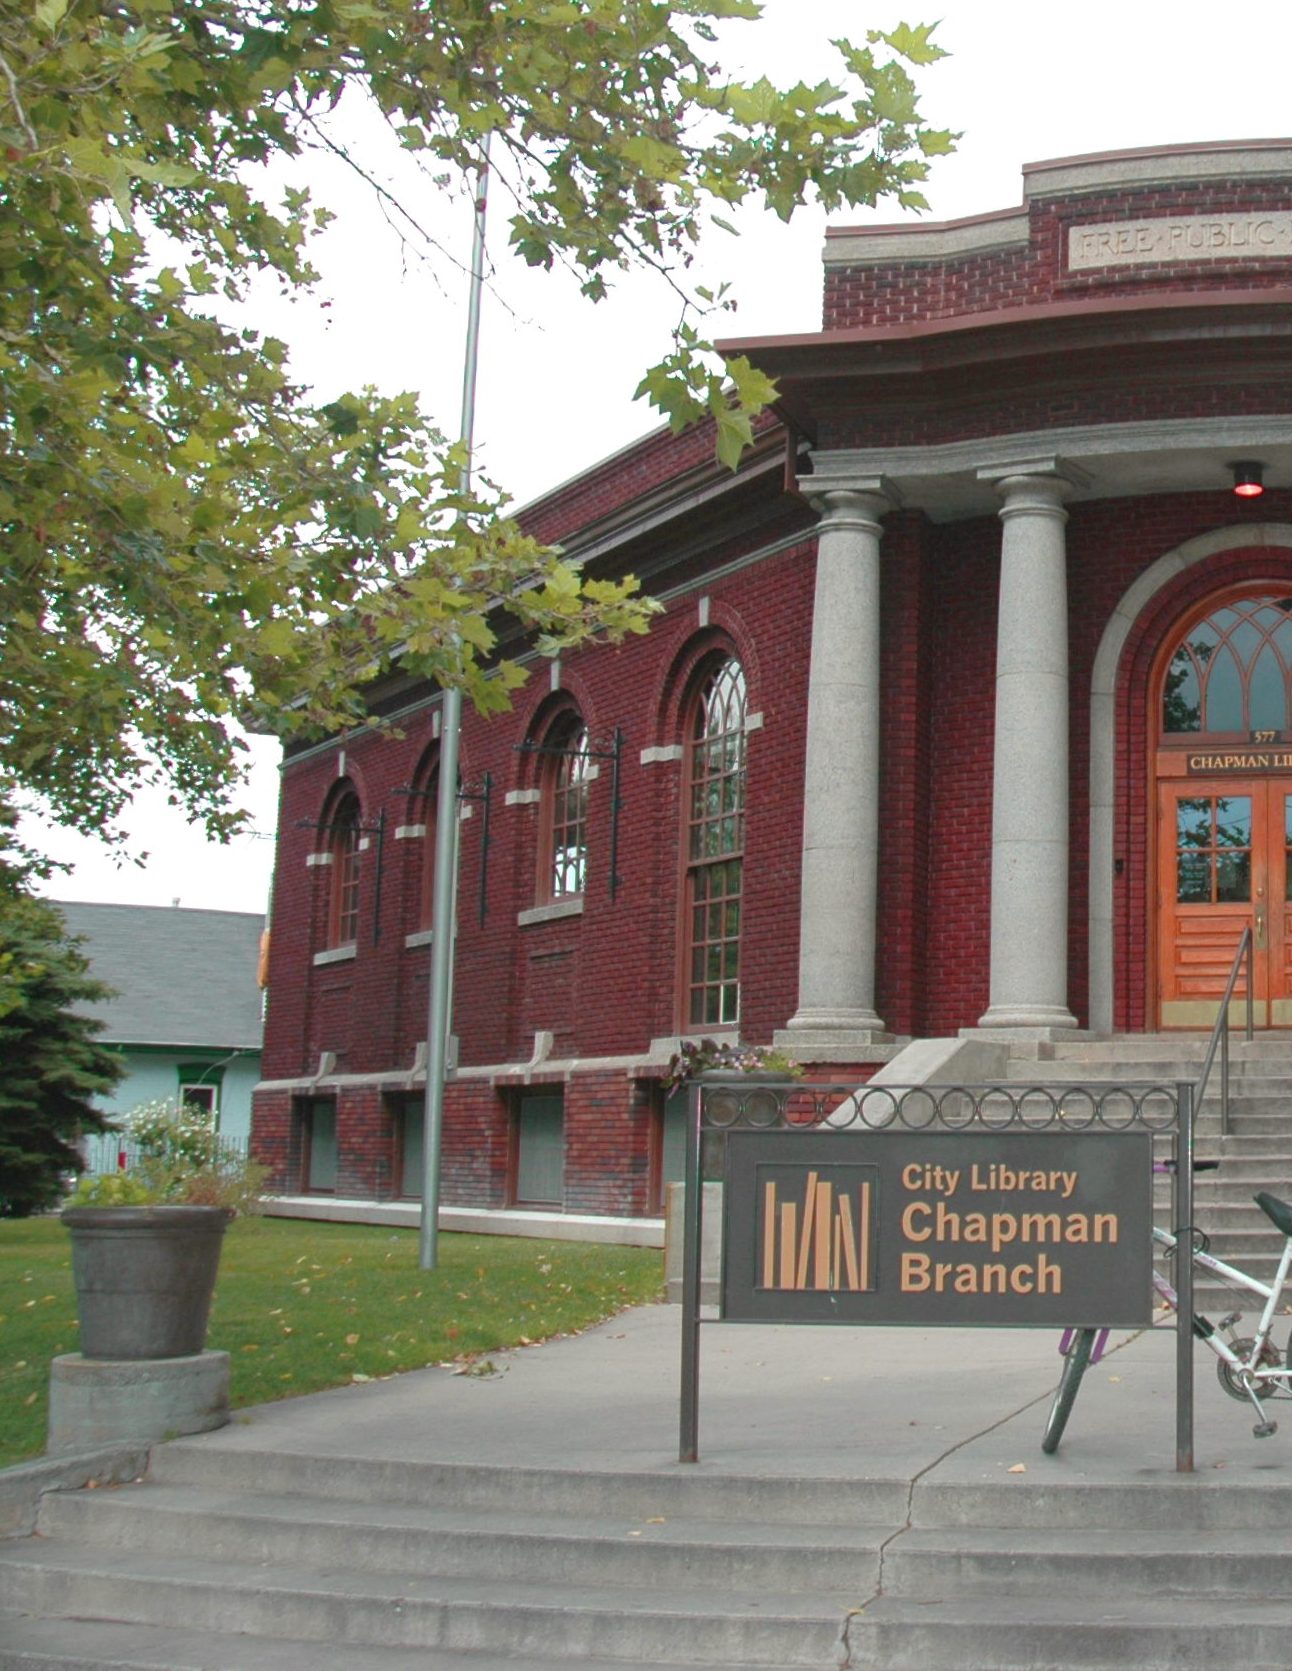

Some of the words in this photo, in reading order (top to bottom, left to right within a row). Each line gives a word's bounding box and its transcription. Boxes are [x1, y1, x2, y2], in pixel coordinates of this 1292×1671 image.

[1080, 228, 1153, 258] FREE
[1168, 219, 1276, 251] PUBLIC
[1254, 730, 1276, 743] 577
[1190, 754, 1270, 769] CHAPMAN
[902, 1163, 960, 1197] City
[971, 1164, 1078, 1198] Library
[902, 1201, 1119, 1253] Chapman
[901, 1252, 1063, 1294] Branch
